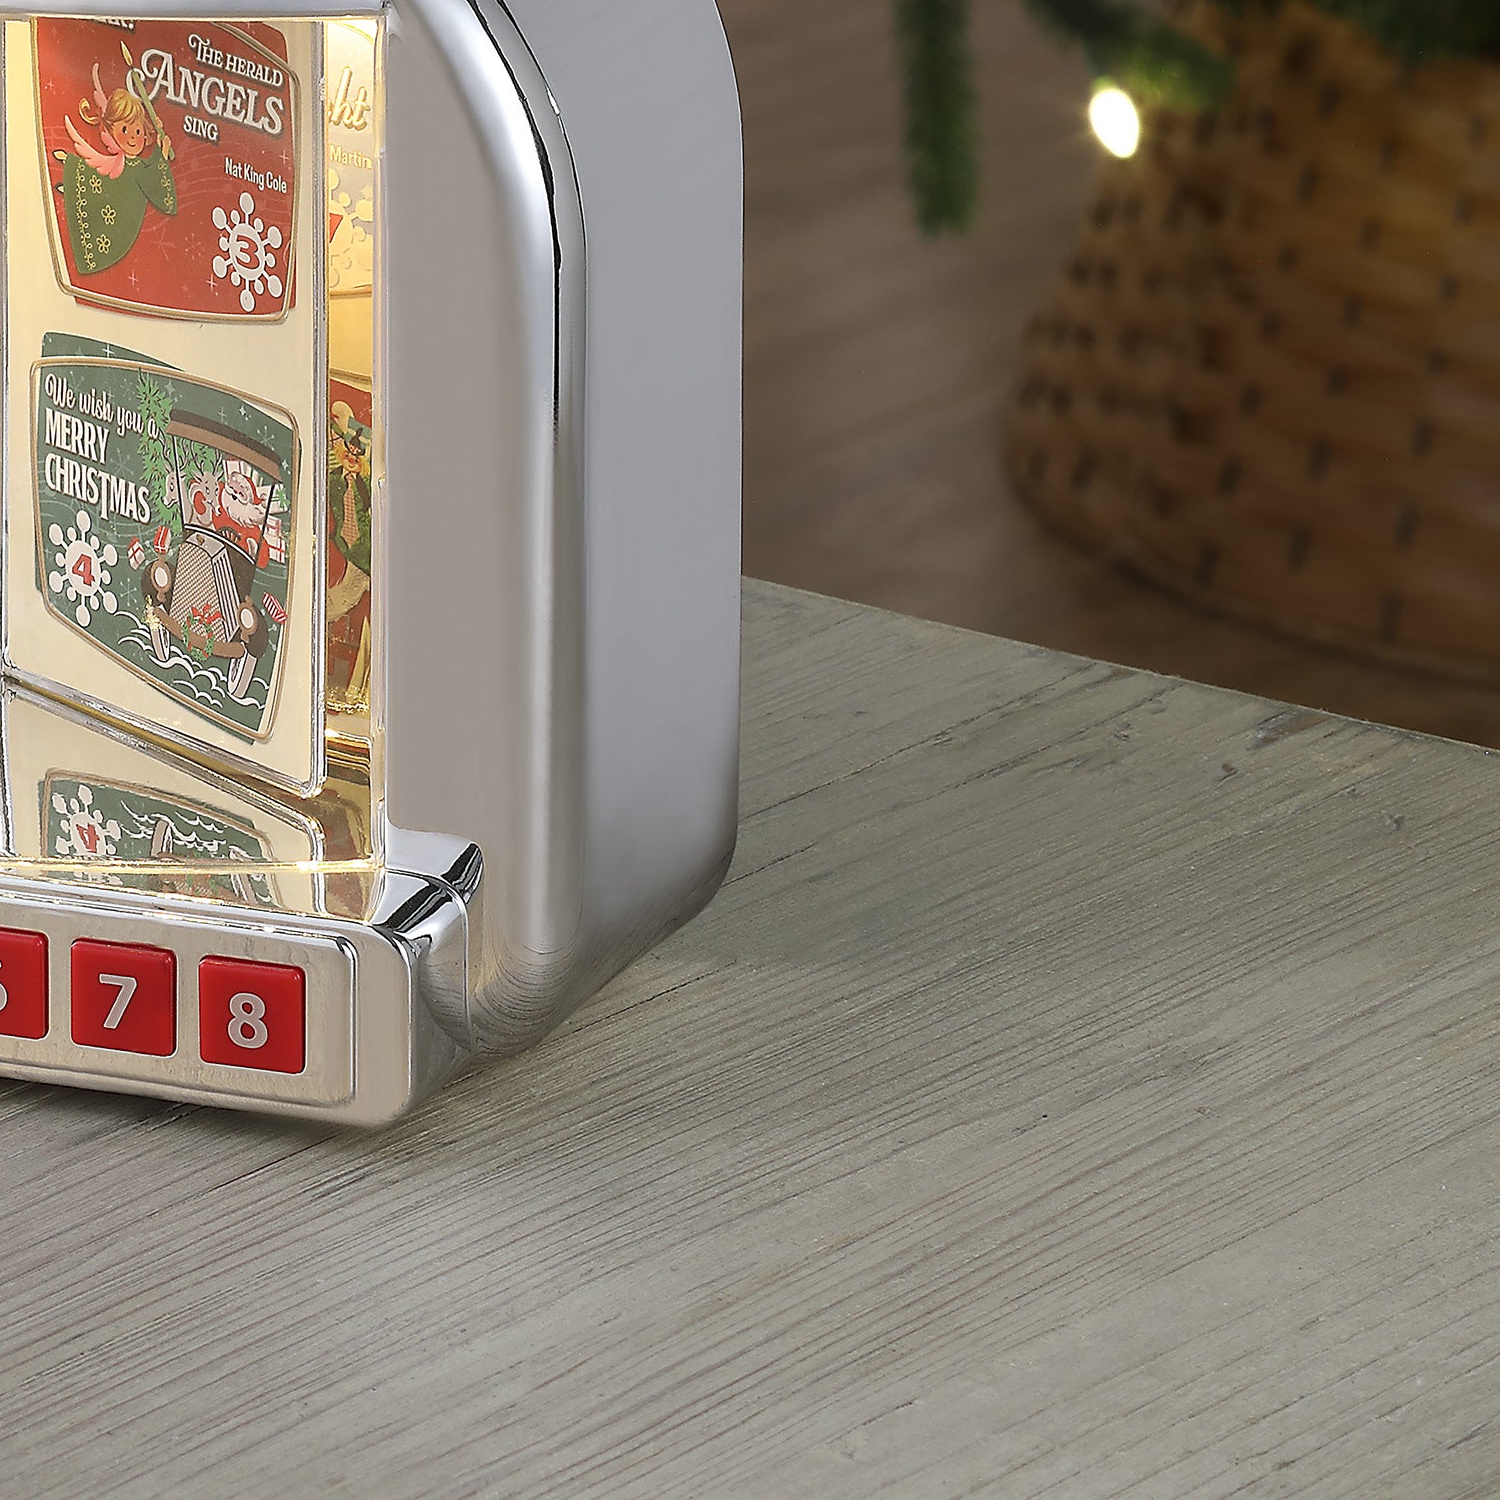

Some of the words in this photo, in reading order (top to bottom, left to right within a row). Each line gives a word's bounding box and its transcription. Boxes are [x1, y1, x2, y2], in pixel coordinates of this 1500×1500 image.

[188, 34, 224, 68] THE
[225, 53, 284, 87] HERALD
[126, 49, 284, 134] ANGELS
[183, 115, 219, 141] SING
[224, 157, 243, 180] Nat
[243, 163, 265, 191] King
[266, 171, 288, 194] Cole
[235, 234, 261, 271] 3
[45, 373, 76, 409] We
[79, 387, 114, 423] wish
[115, 407, 145, 437] you
[146, 417, 159, 440] a
[45, 407, 110, 465] MERRY
[45, 452, 151, 524] CHRISTMAS
[71, 553, 96, 587] 4
[97, 972, 139, 1030] 7
[226, 991, 270, 1050] 8
